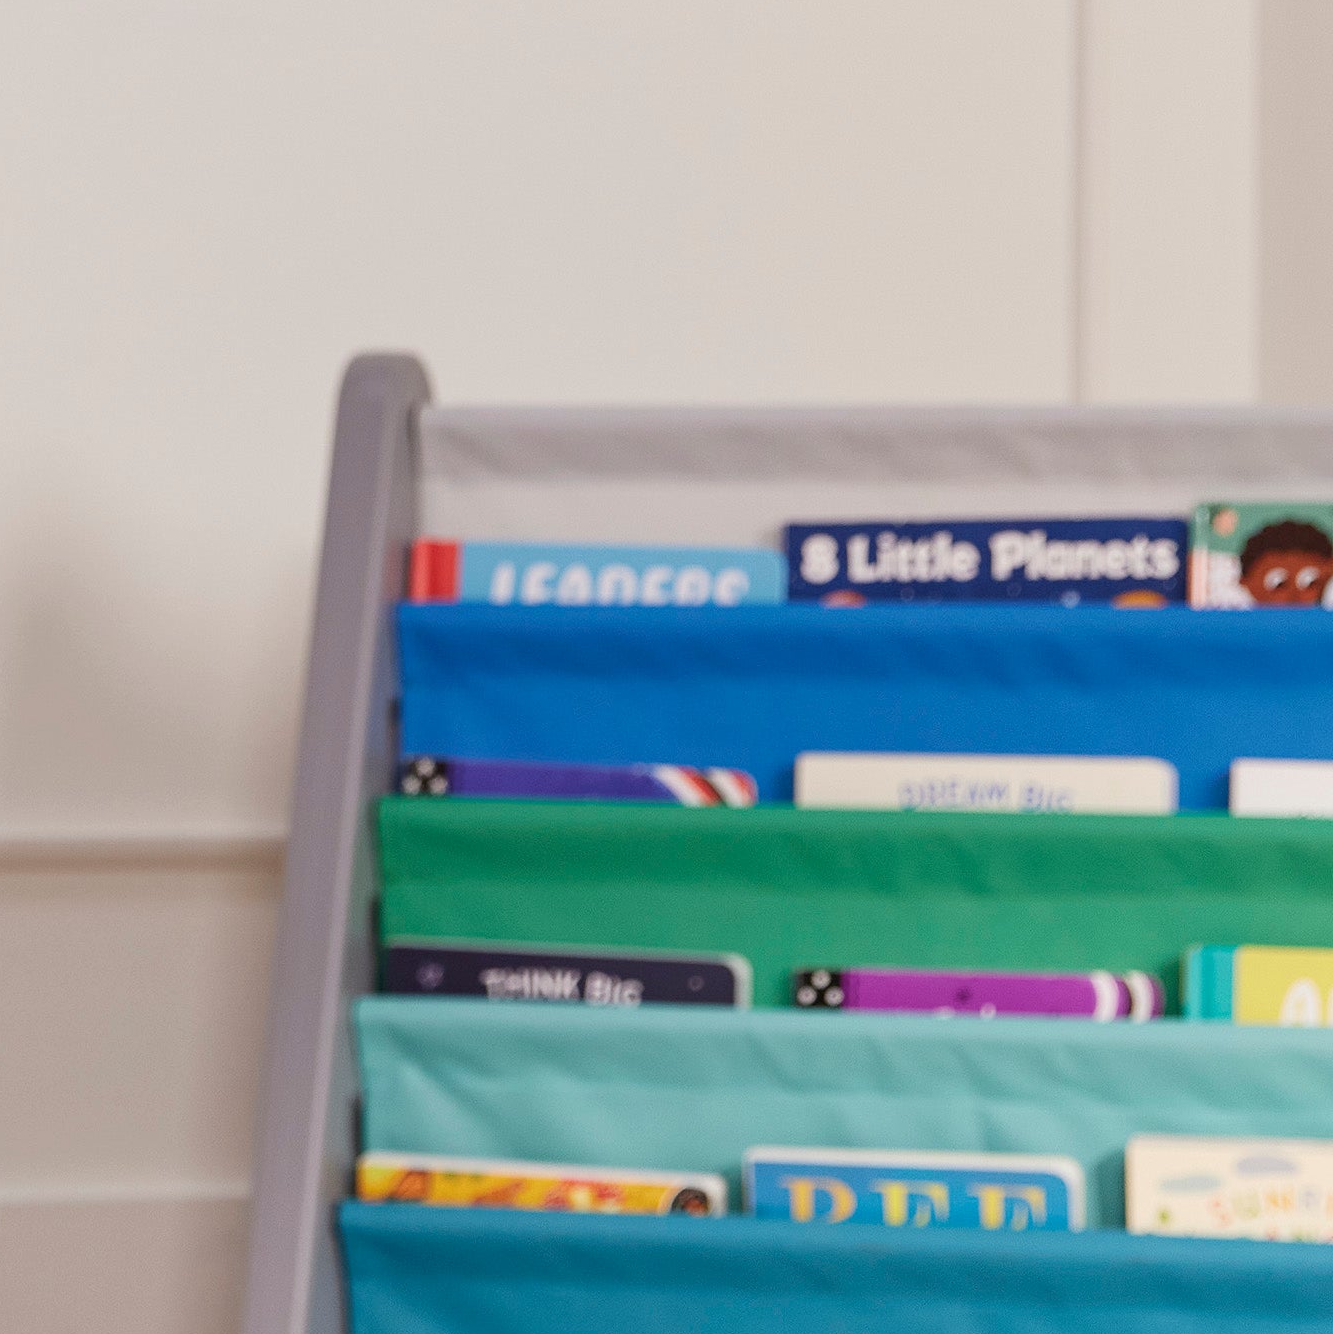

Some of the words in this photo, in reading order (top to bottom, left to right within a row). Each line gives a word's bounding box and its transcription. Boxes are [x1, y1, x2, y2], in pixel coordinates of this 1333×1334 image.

[800, 533, 839, 584] 8
[846, 530, 981, 584] Little
[988, 529, 1179, 581] Planets
